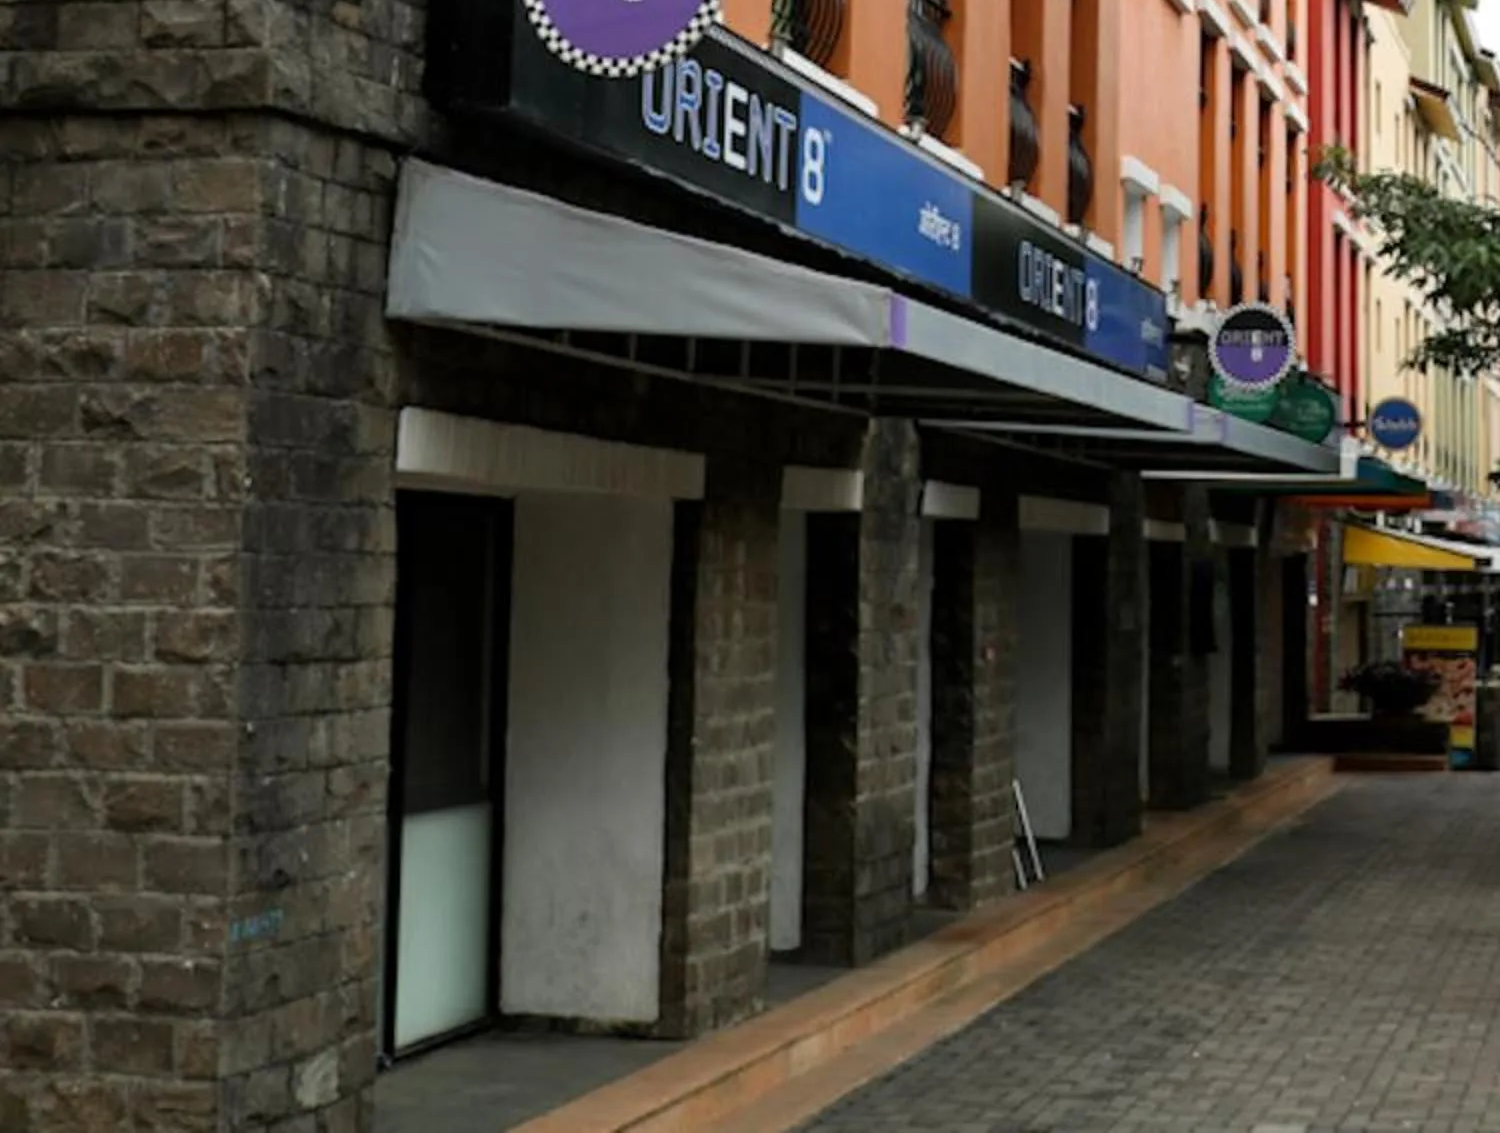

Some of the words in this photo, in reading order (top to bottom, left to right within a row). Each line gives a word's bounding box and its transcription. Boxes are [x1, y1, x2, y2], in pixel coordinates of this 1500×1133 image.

[641, 58, 797, 191] ORIENT
[802, 126, 825, 205] 8
[1019, 239, 1085, 327] ORIENT
[1085, 278, 1098, 332] 8
[1221, 329, 1284, 345] ORIENT
